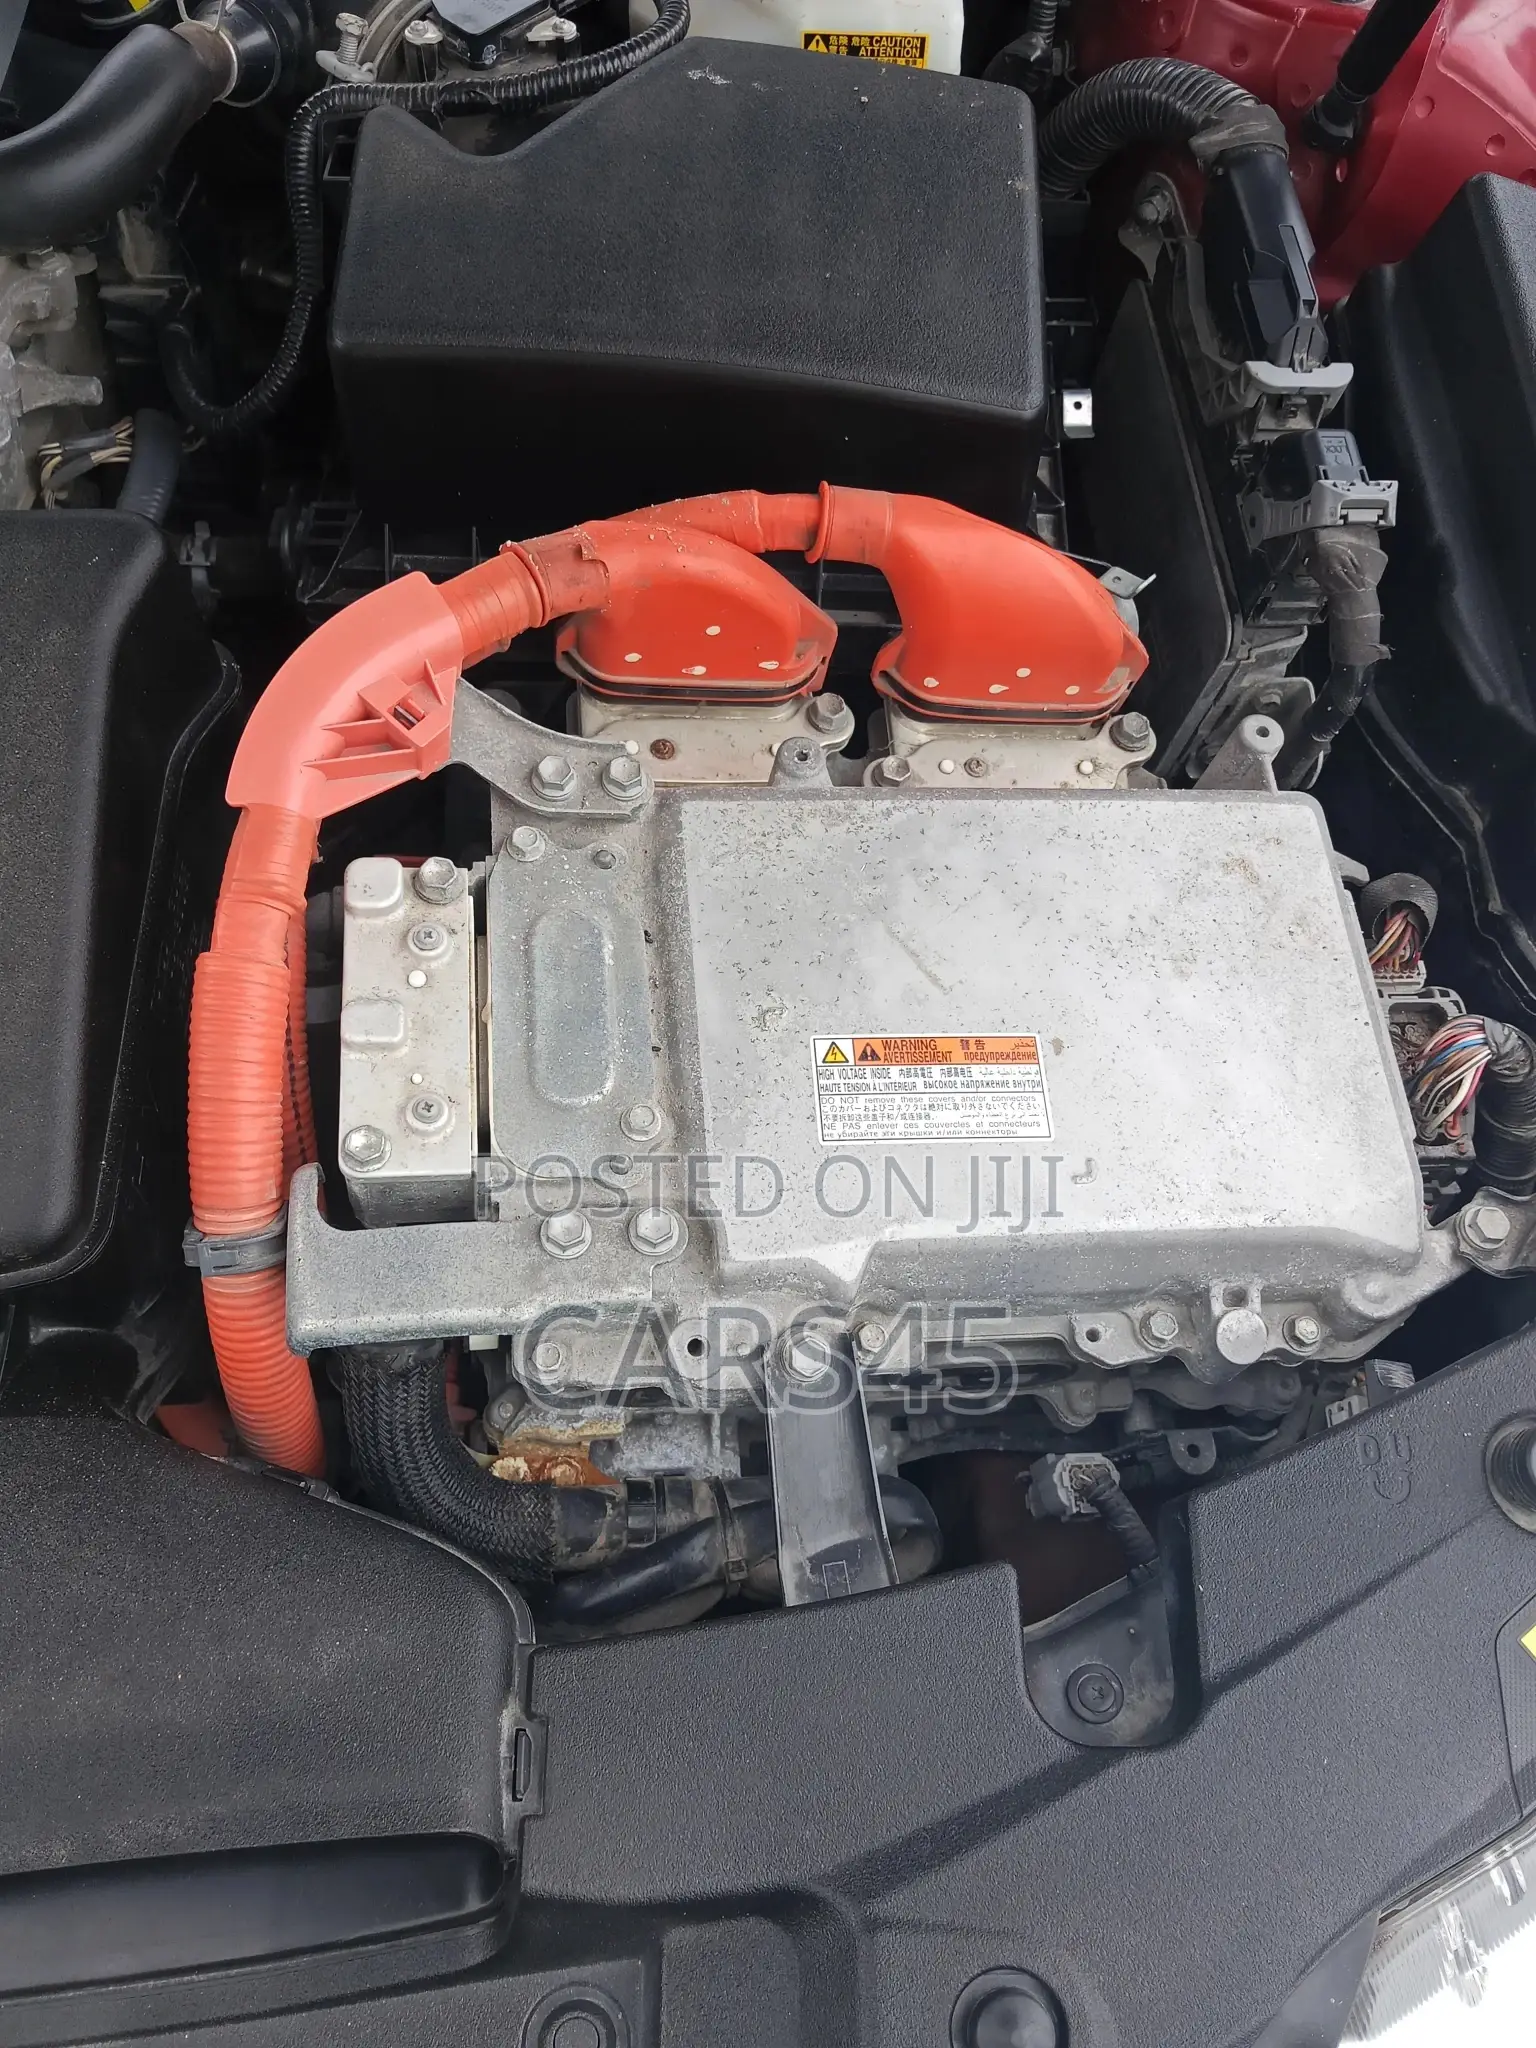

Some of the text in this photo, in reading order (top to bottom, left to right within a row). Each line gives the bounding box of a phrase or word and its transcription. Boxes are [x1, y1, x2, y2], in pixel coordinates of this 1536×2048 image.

[872, 36, 921, 47] CAUTION
[859, 46, 920, 57] ATTENTION
[881, 1039, 938, 1051] WARNING
[883, 1050, 953, 1063] AVERTISSEMENT
[964, 1051, 1037, 1063] предупреждение
[818, 1067, 892, 1081] HIGH VOLTAGE INSIDE
[820, 1082, 842, 1093] HAUTE
[843, 1082, 871, 1092] TENSION
[961, 1079, 1010, 1092] напряжение
[821, 1097, 835, 1105] DO
[840, 1096, 860, 1104] NOT
[900, 1095, 924, 1103] these
[960, 1095, 987, 1103] and/or
[842, 1122, 861, 1130] PAS
[924, 1121, 970, 1129] couvercles
[989, 1120, 1041, 1128] connecteurs
